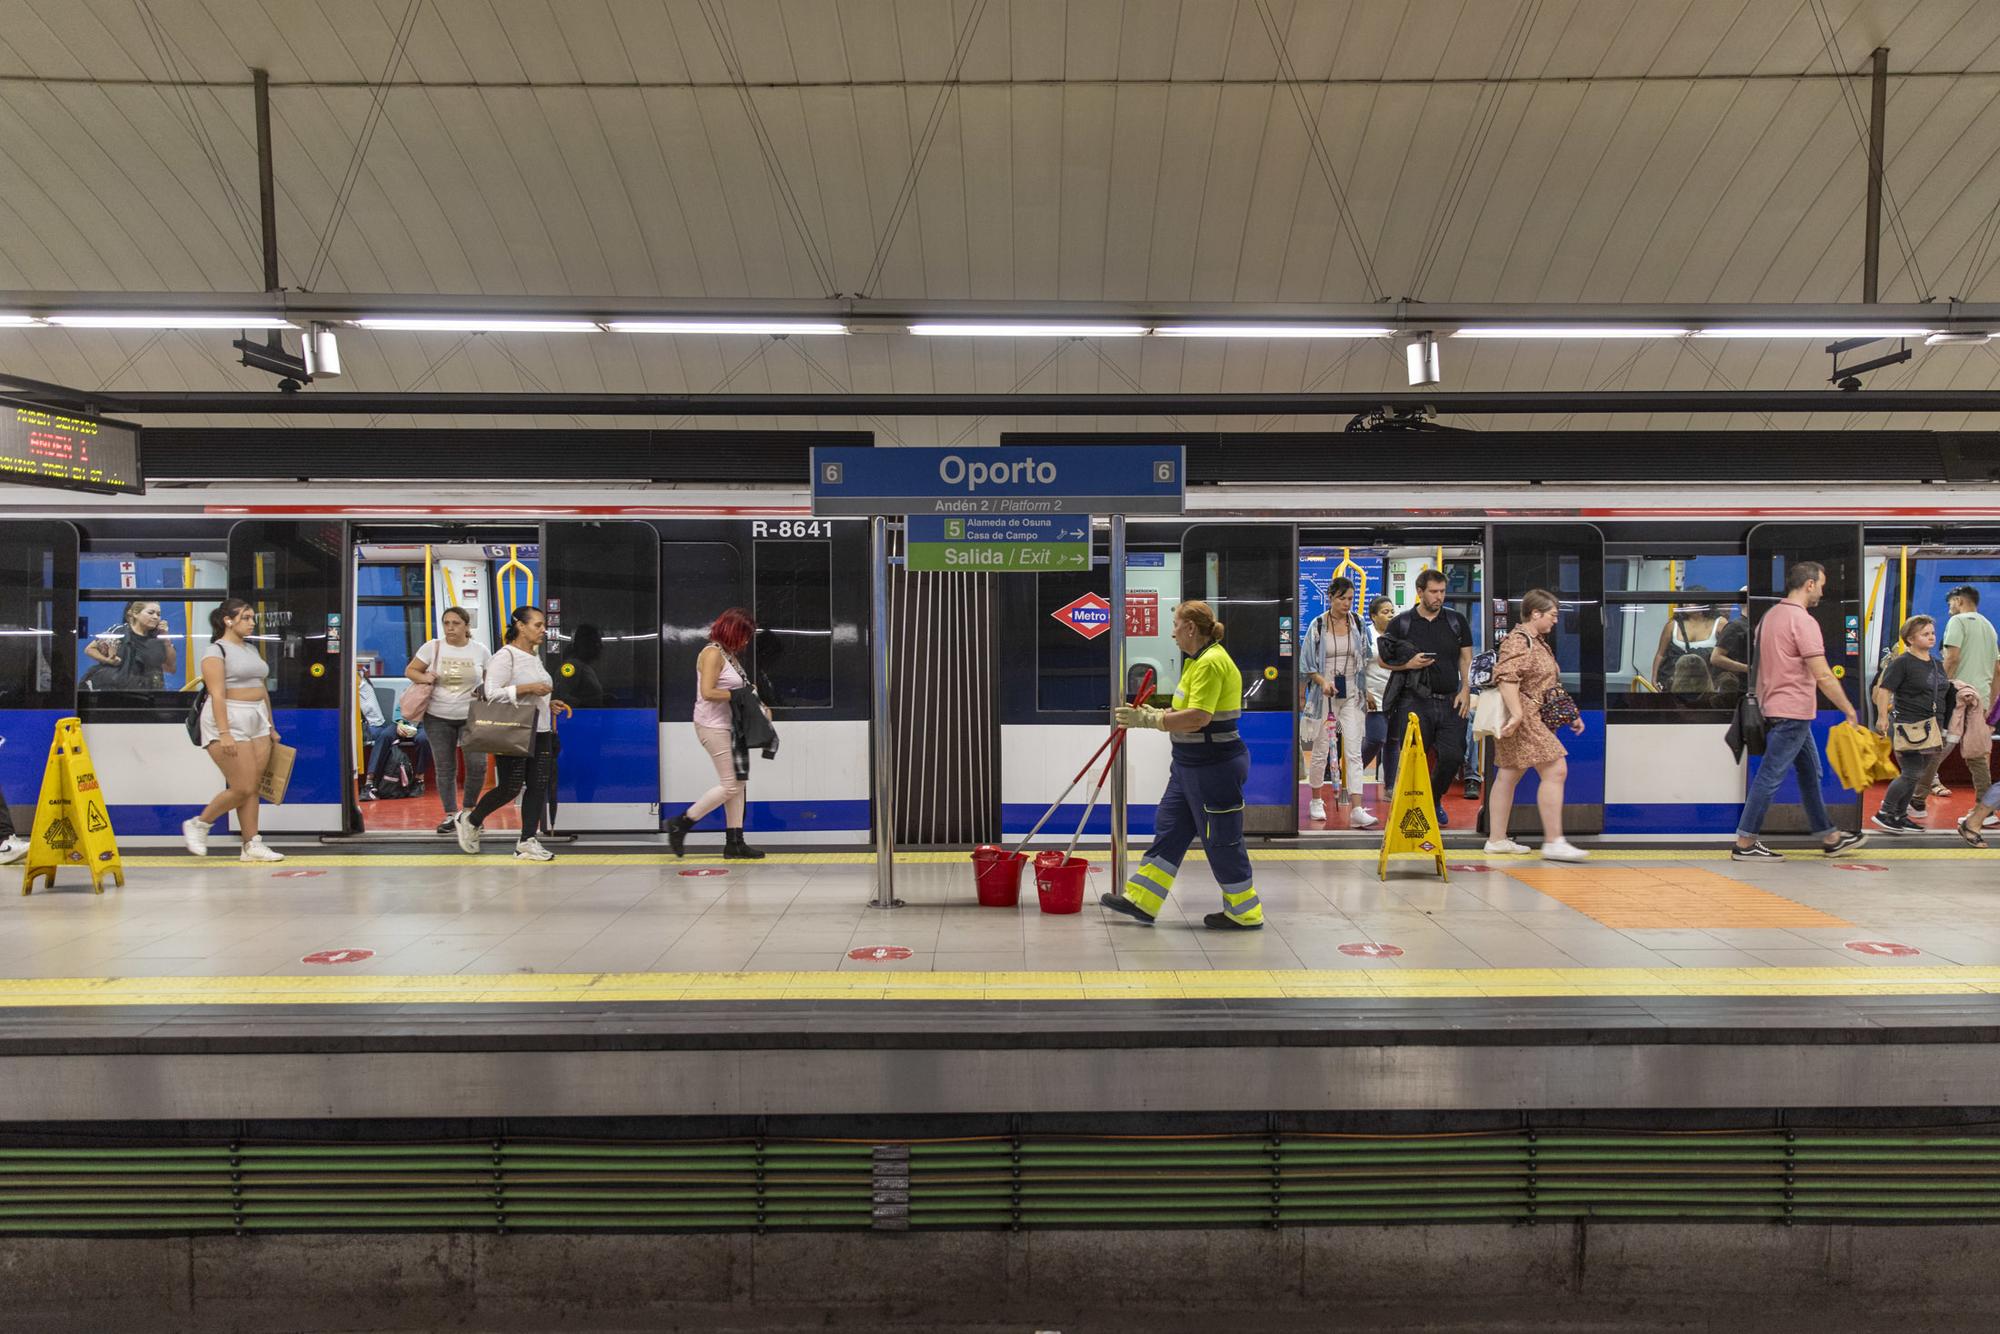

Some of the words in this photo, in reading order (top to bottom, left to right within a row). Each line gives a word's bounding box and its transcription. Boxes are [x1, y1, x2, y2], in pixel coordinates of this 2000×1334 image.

[826, 465, 838, 481] 6
[939, 455, 1057, 491] Oporto
[1158, 464, 1170, 480] 6
[934, 499, 977, 512] Andén
[980, 500, 989, 511] 2
[991, 500, 998, 513] /
[1000, 499, 1051, 512] Platform
[1053, 500, 1063, 511] 2
[752, 521, 832, 537] R-8641
[949, 521, 960, 537] 5
[966, 518, 1005, 527] Alameda
[1008, 517, 1021, 527] de
[1022, 518, 1052, 527] Osuna
[966, 531, 989, 541] Casa
[992, 530, 1004, 541] de
[1006, 531, 1038, 542] Campo
[945, 548, 1004, 565] Salida
[1008, 547, 1016, 567] /
[1019, 548, 1051, 565] Exit
[1074, 610, 1107, 621] Metro
[77, 773, 95, 783] CAUTION
